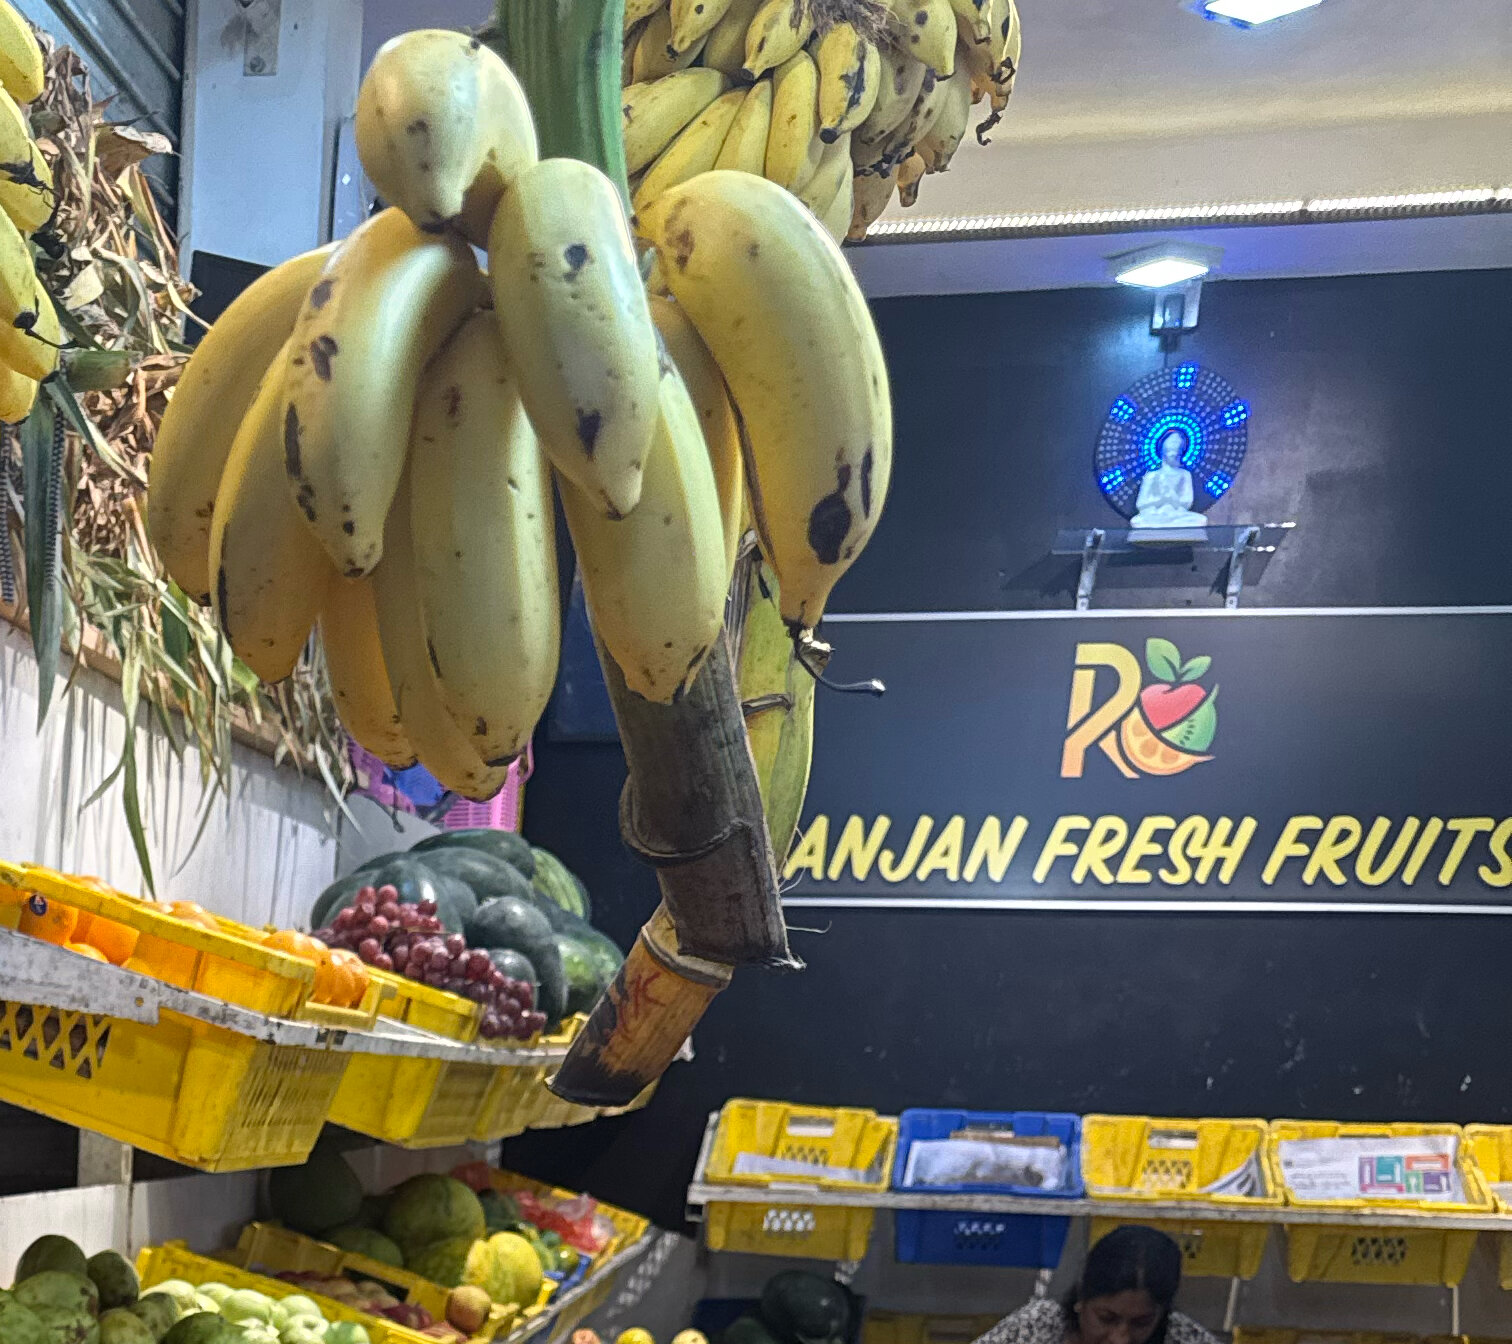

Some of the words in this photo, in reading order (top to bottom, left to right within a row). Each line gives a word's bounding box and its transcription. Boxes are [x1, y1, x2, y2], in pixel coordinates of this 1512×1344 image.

[782, 814, 1029, 883] ANJAN
[1032, 814, 1258, 885] FRESH
[1261, 815, 1512, 887] FRUITS
